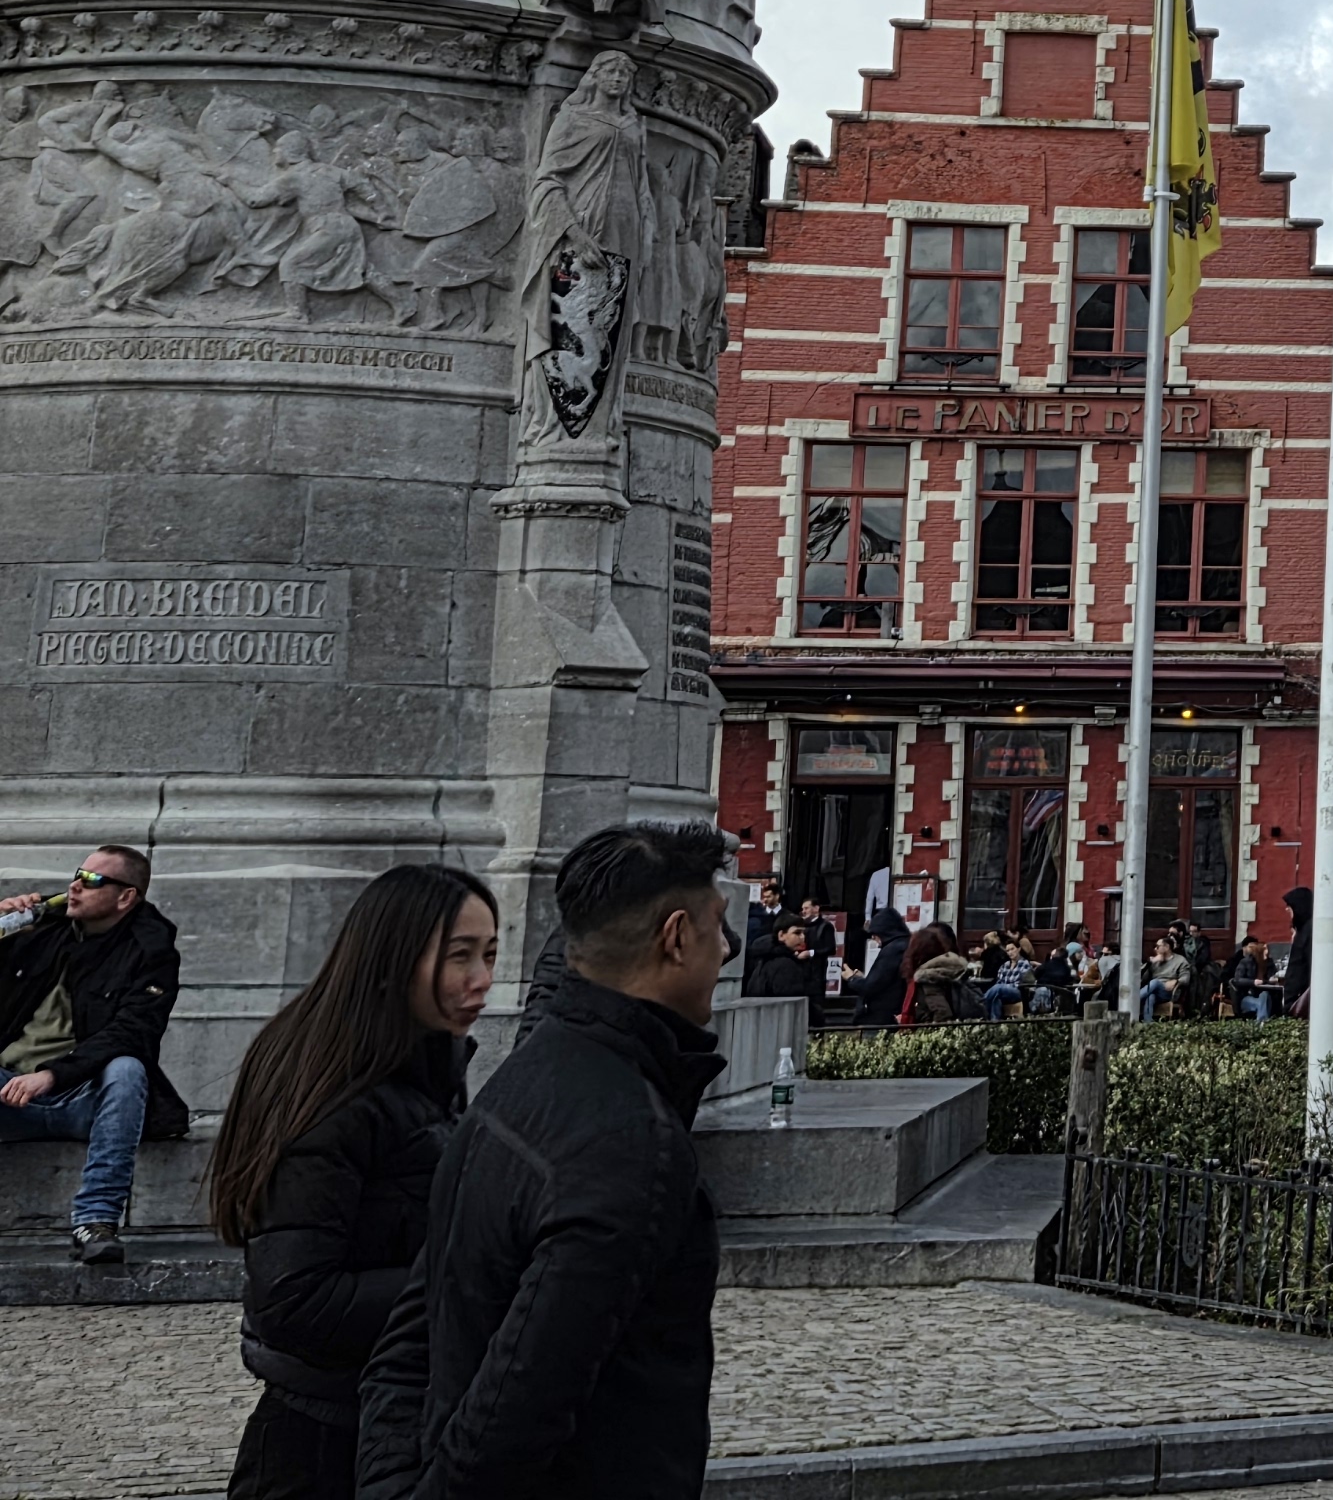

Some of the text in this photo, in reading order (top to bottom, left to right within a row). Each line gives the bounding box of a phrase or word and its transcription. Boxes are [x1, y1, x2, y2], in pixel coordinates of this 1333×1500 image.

[867, 405, 919, 430] LE
[933, 399, 1091, 433] PANIER
[52, 580, 327, 618] JAN BREIDEL
[36, 631, 155, 665] PIETER
